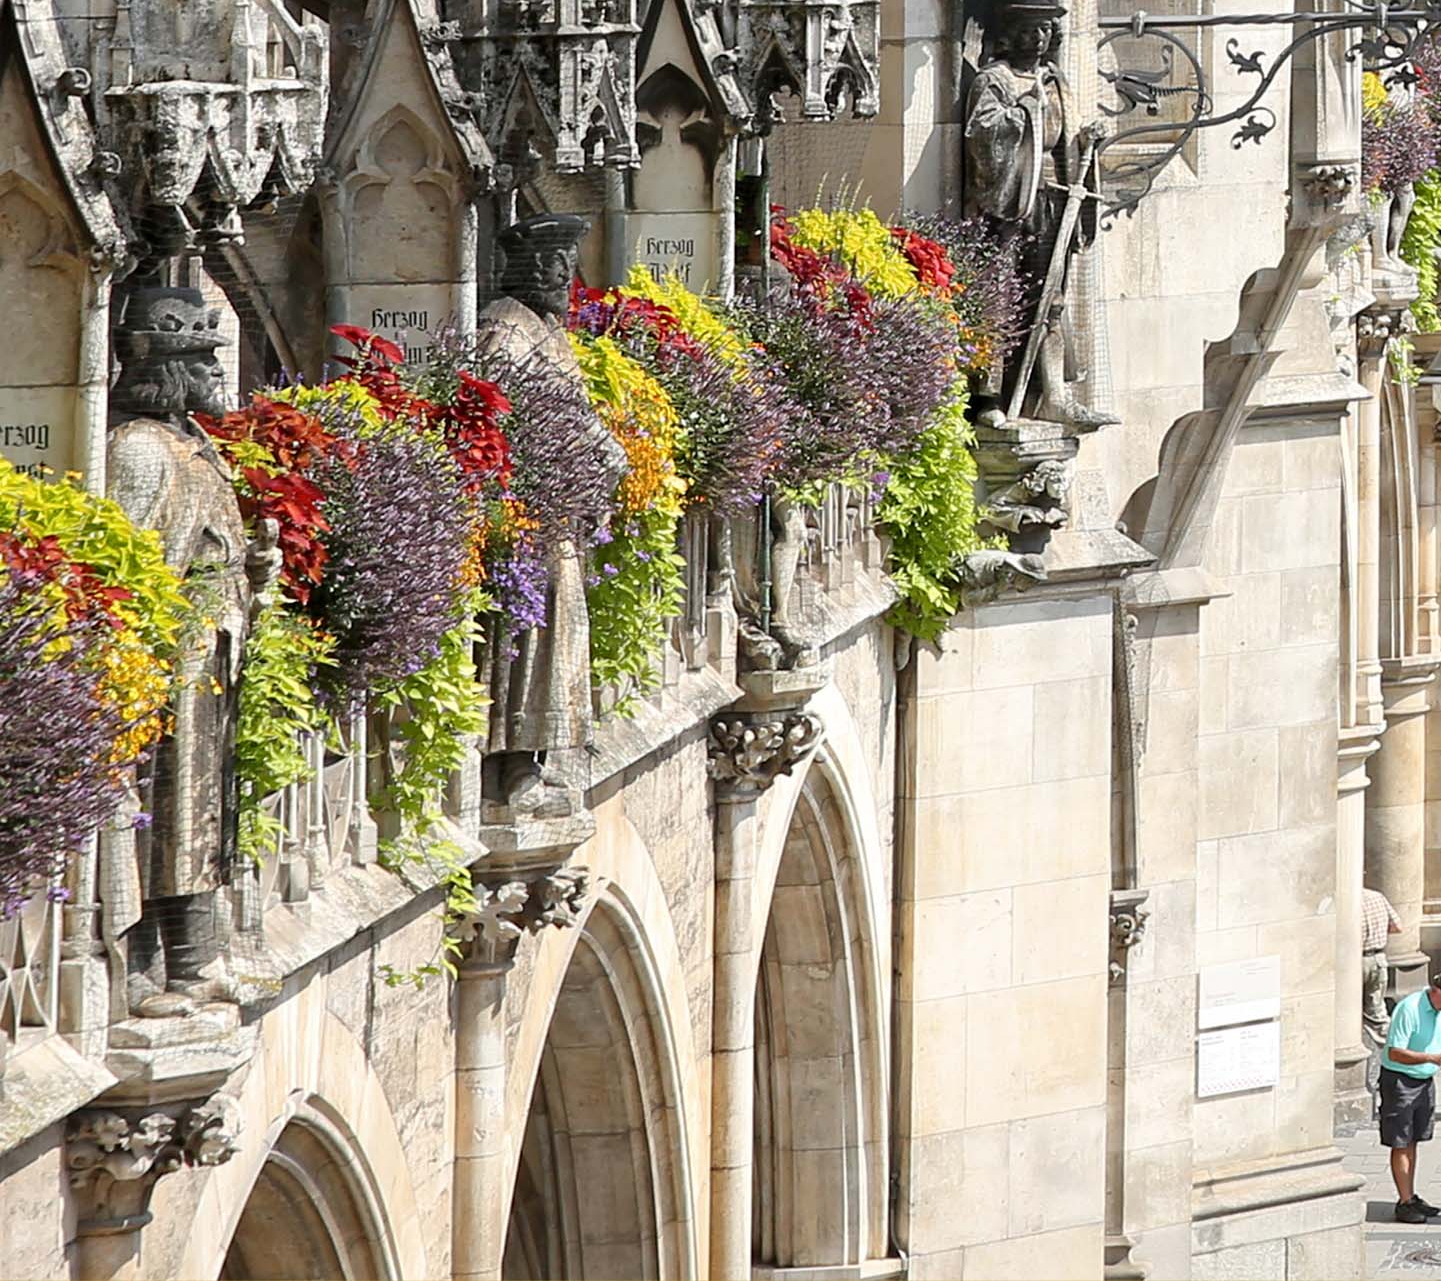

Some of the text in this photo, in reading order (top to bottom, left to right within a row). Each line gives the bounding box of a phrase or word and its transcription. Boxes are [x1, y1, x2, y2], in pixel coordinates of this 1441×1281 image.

[646, 237, 694, 257] Herzog
[372, 309, 428, 331] Herzog
[0, 424, 49, 450] rzog
